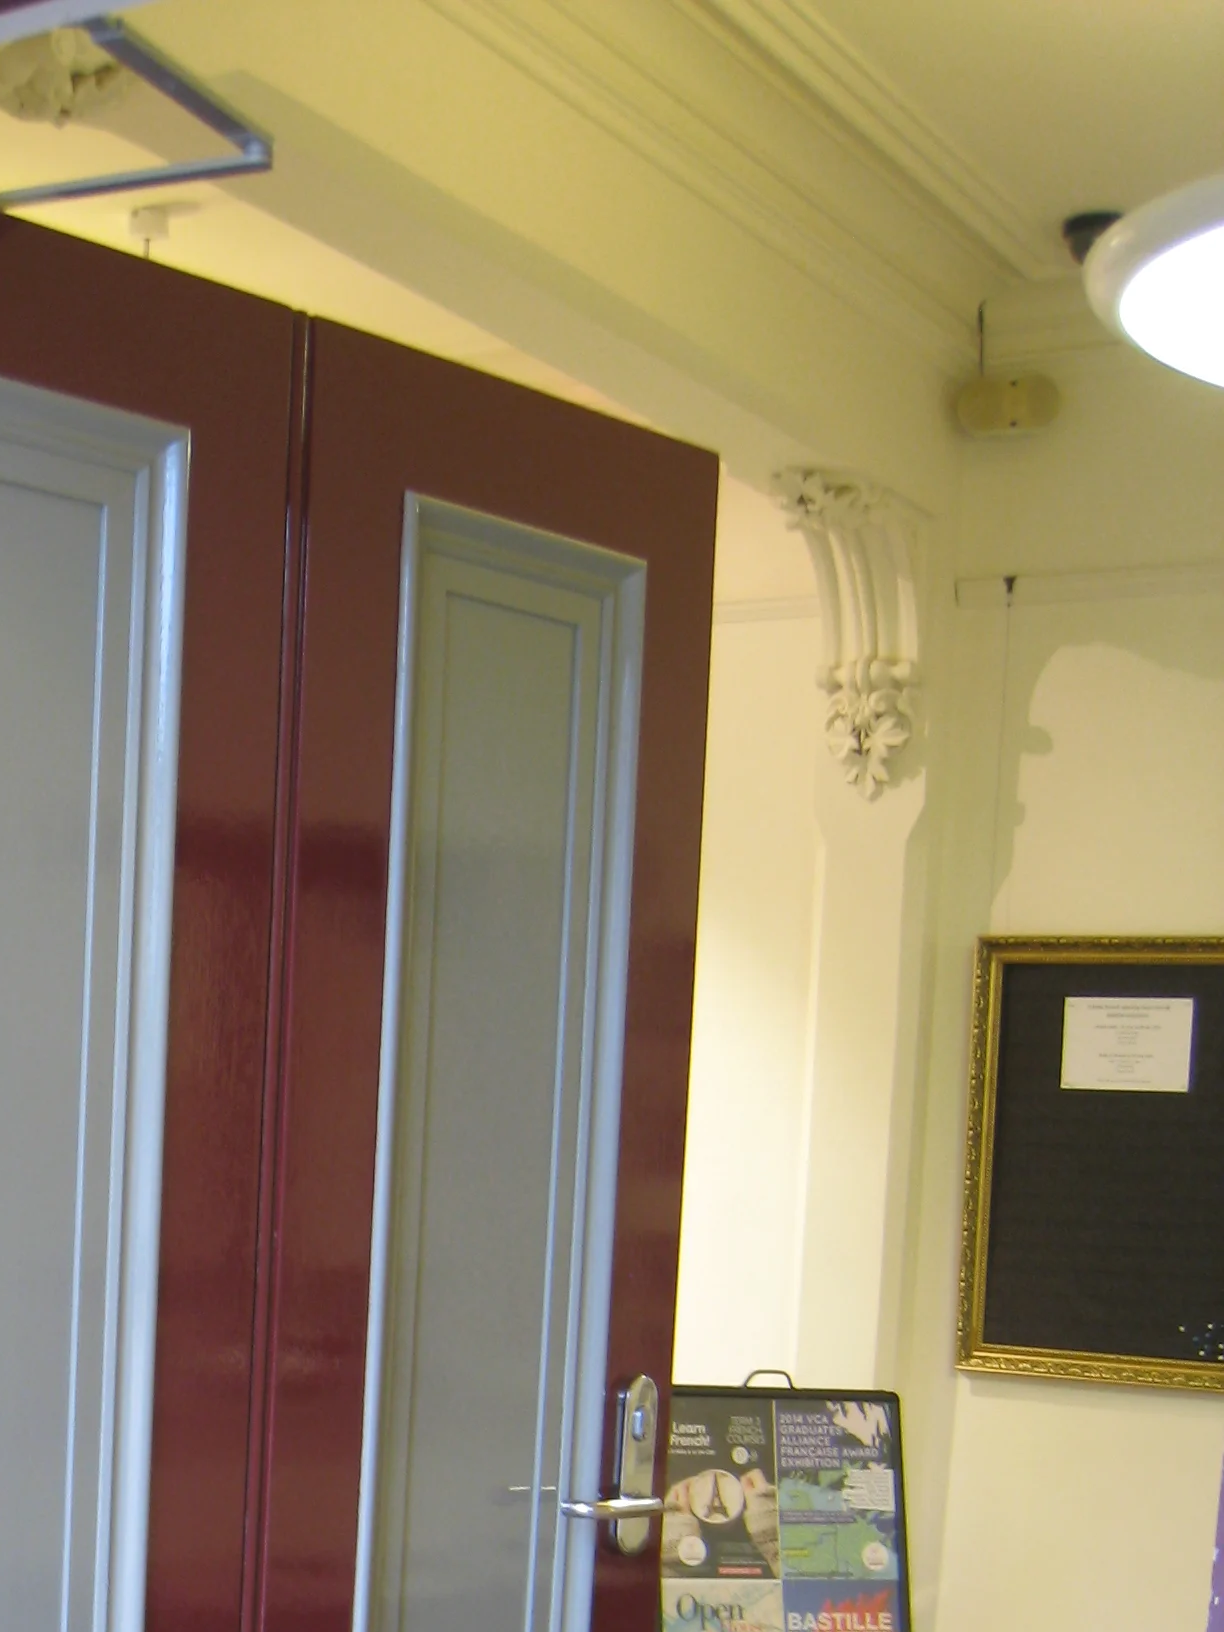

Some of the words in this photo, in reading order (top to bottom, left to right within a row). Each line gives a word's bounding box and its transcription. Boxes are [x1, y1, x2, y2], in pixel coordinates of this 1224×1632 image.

[806, 1414, 829, 1424] VCA
[672, 1421, 706, 1434] Learn
[781, 1436, 830, 1446] ALLIANCE
[842, 1448, 879, 1457] AWARD
[781, 1458, 840, 1467] EXHIBITION
[677, 1593, 744, 1631] Open
[788, 1612, 893, 1630] BASTILLE
